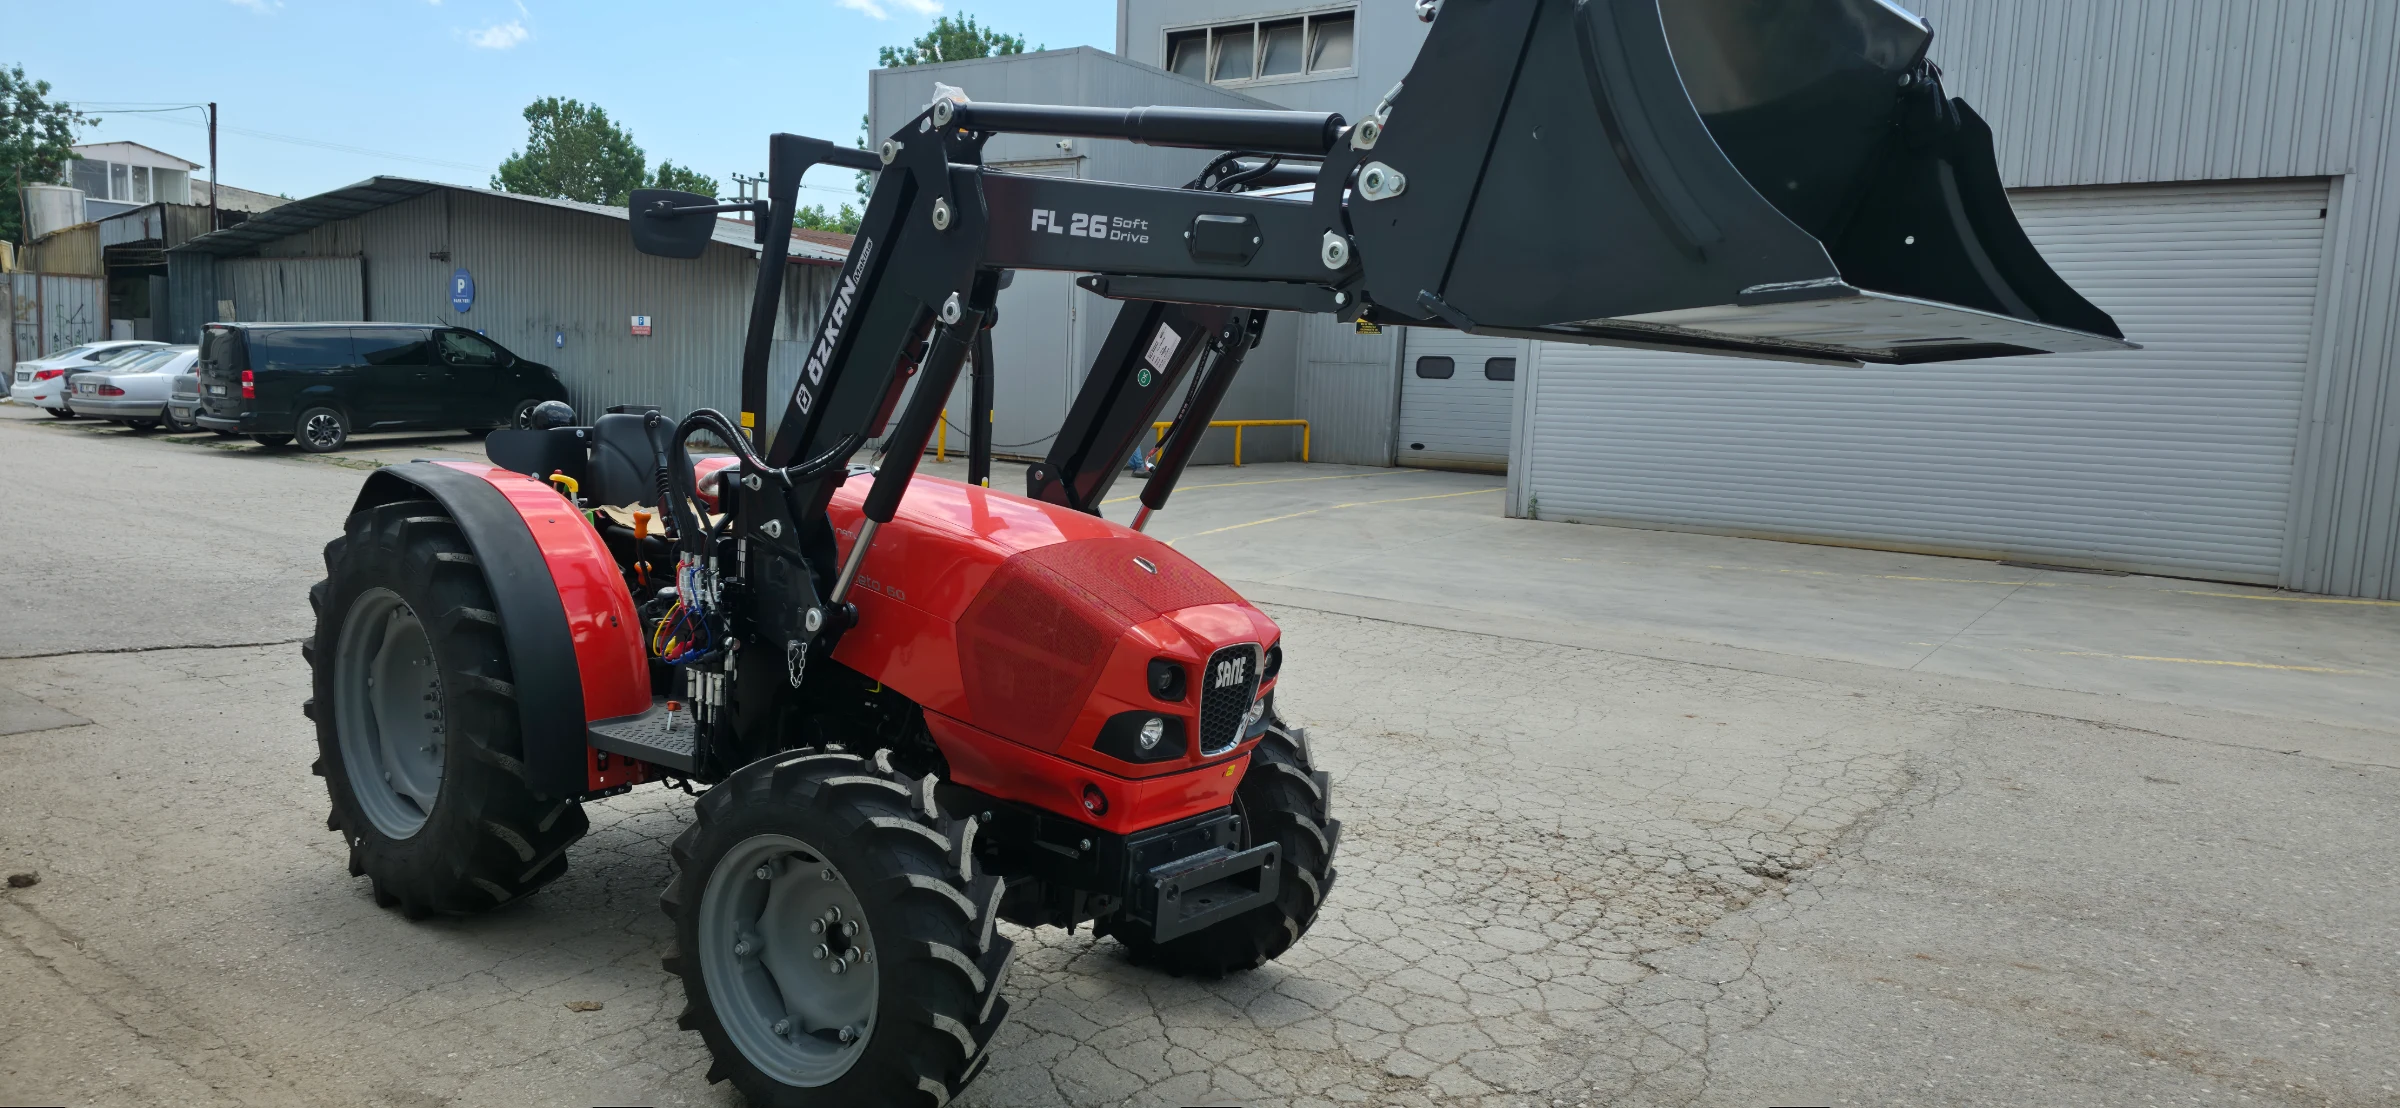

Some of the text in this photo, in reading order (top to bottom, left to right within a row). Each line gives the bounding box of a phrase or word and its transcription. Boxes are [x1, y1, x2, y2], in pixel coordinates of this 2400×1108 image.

[1031, 208, 1108, 239] FL 26
[1112, 216, 1149, 230] Soft
[1109, 230, 1149, 243] Drive
[457, 278, 466, 293] P
[807, 275, 857, 385] ÖZKAN
[556, 334, 562, 345] 4
[886, 585, 906, 601] 60
[1215, 656, 1247, 689] SAME
